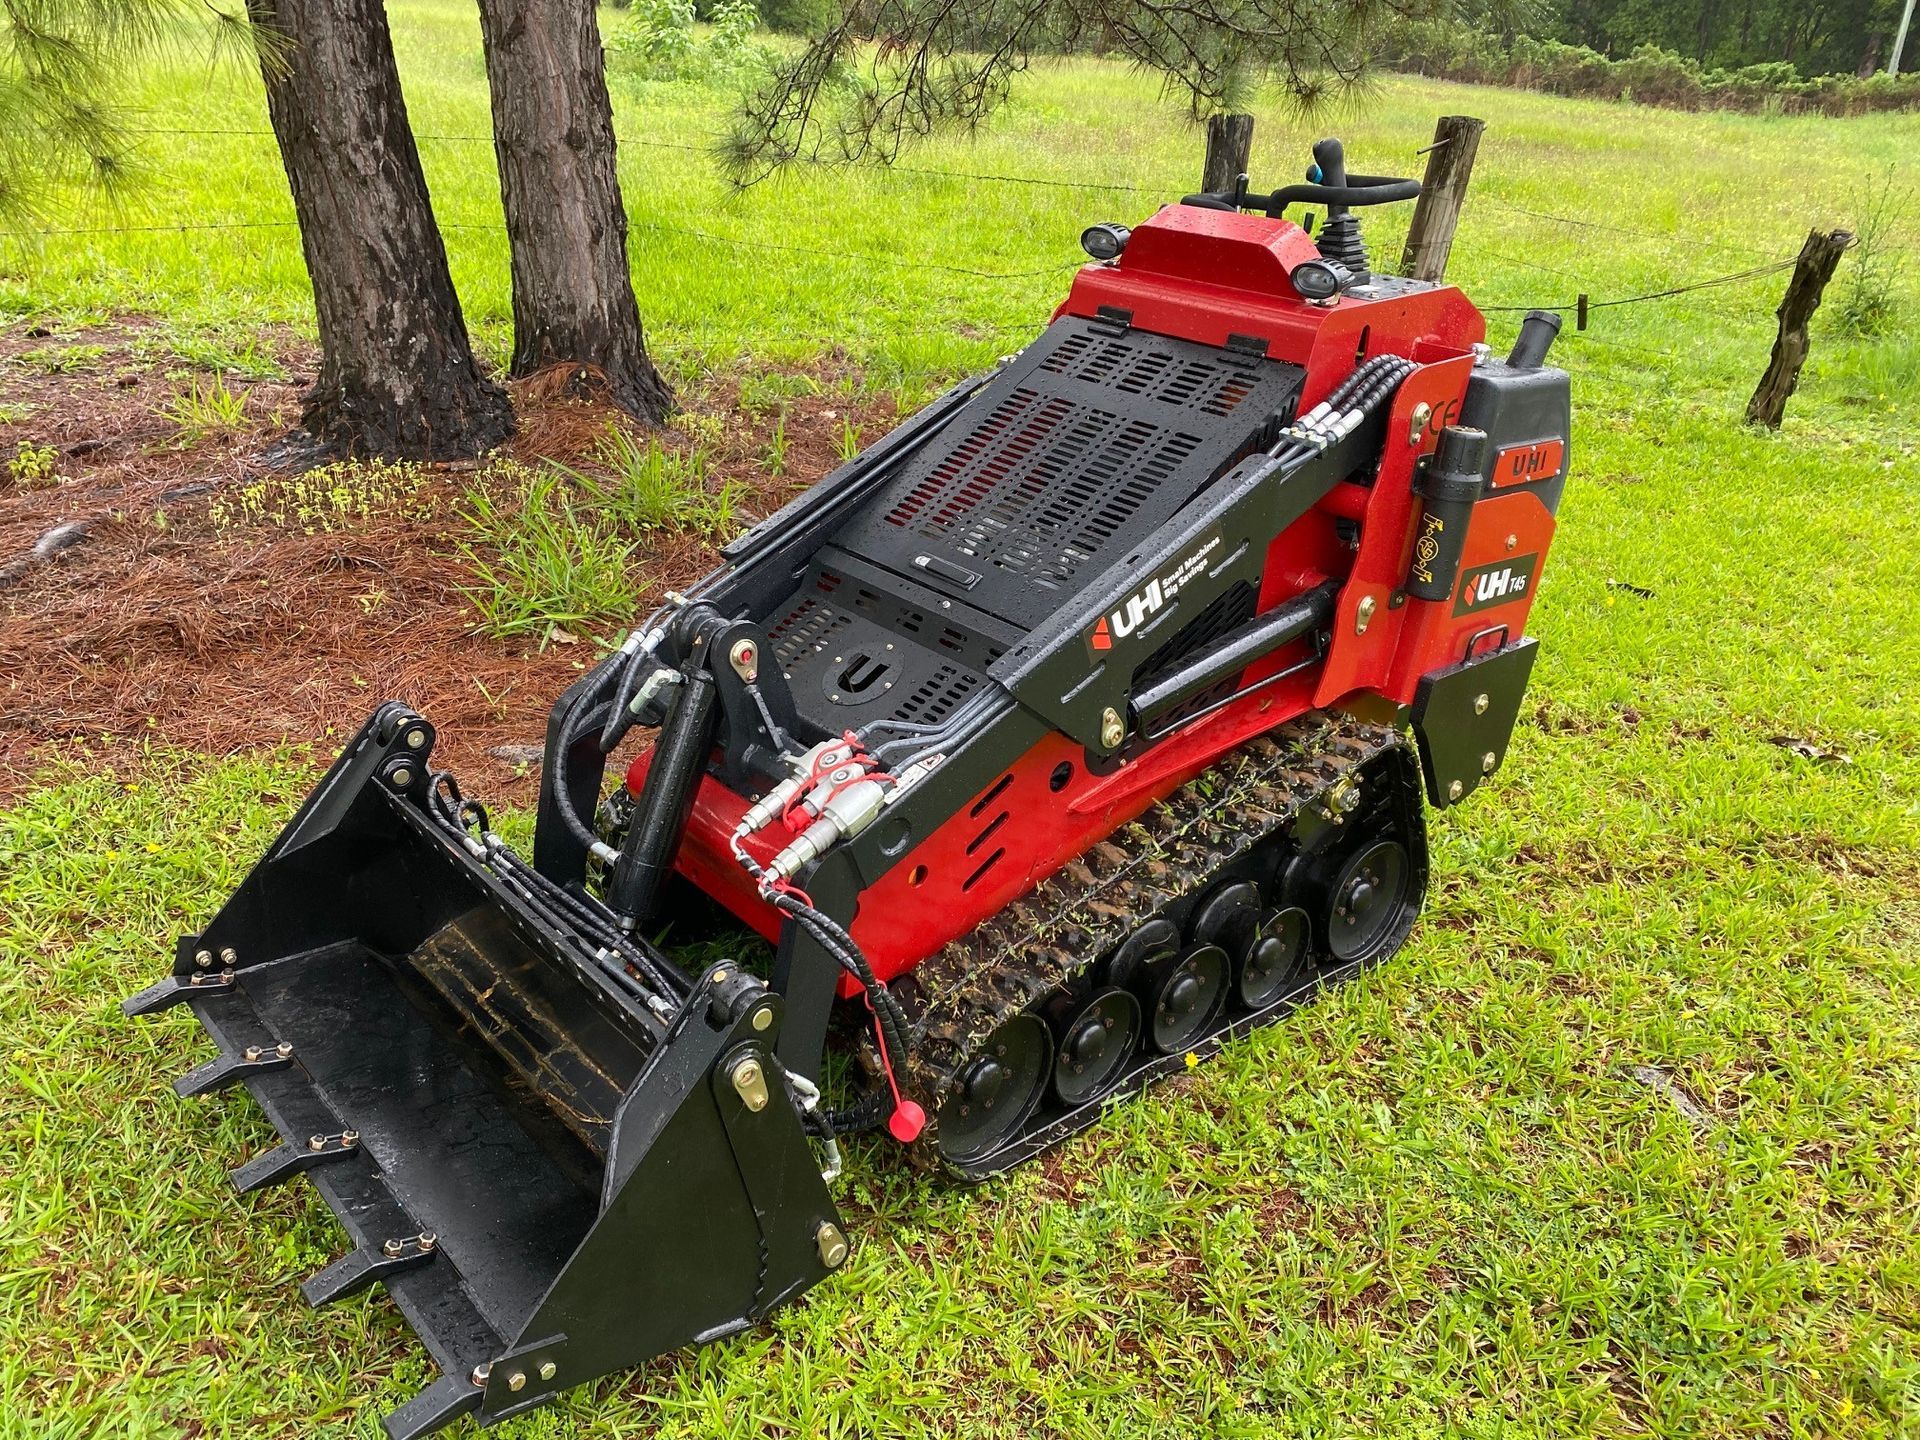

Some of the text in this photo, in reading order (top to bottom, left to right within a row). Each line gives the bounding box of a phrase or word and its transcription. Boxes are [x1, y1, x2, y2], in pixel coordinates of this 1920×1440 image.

[1513, 450, 1548, 476] UHI
[1162, 536, 1220, 589] Small Machines
[1164, 558, 1208, 599] Big Savings
[1477, 568, 1527, 602] UHI T45
[1111, 578, 1164, 638] UHI
